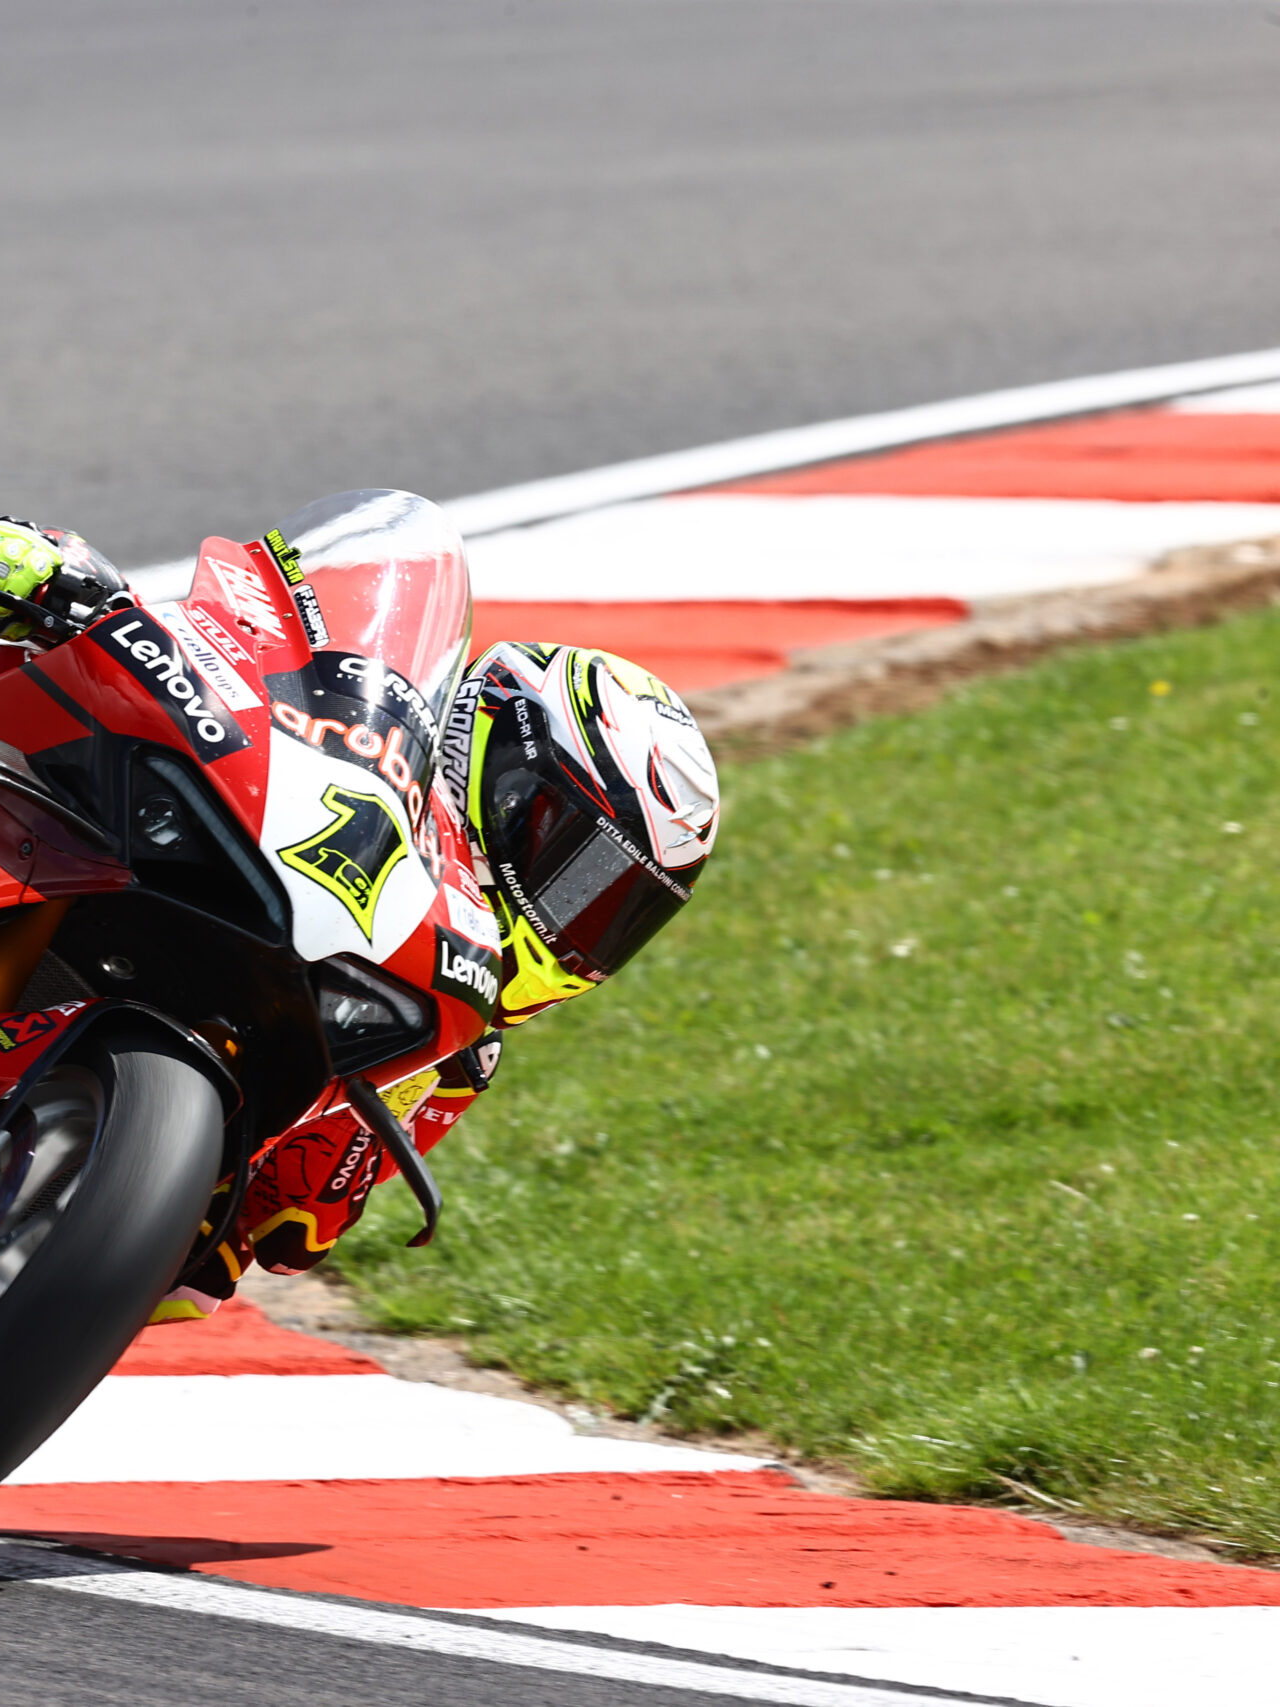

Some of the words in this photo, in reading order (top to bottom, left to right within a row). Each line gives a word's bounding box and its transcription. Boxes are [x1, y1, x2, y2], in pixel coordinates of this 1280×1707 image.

[189, 609, 247, 662] STULZ
[111, 620, 225, 742] Lenovo
[524, 744, 538, 760] AIR
[276, 783, 408, 948] 1
[596, 816, 624, 843] DITTA
[622, 839, 648, 864] EDILE
[645, 860, 673, 888] BALDINI
[499, 862, 558, 944] Motostorm.it
